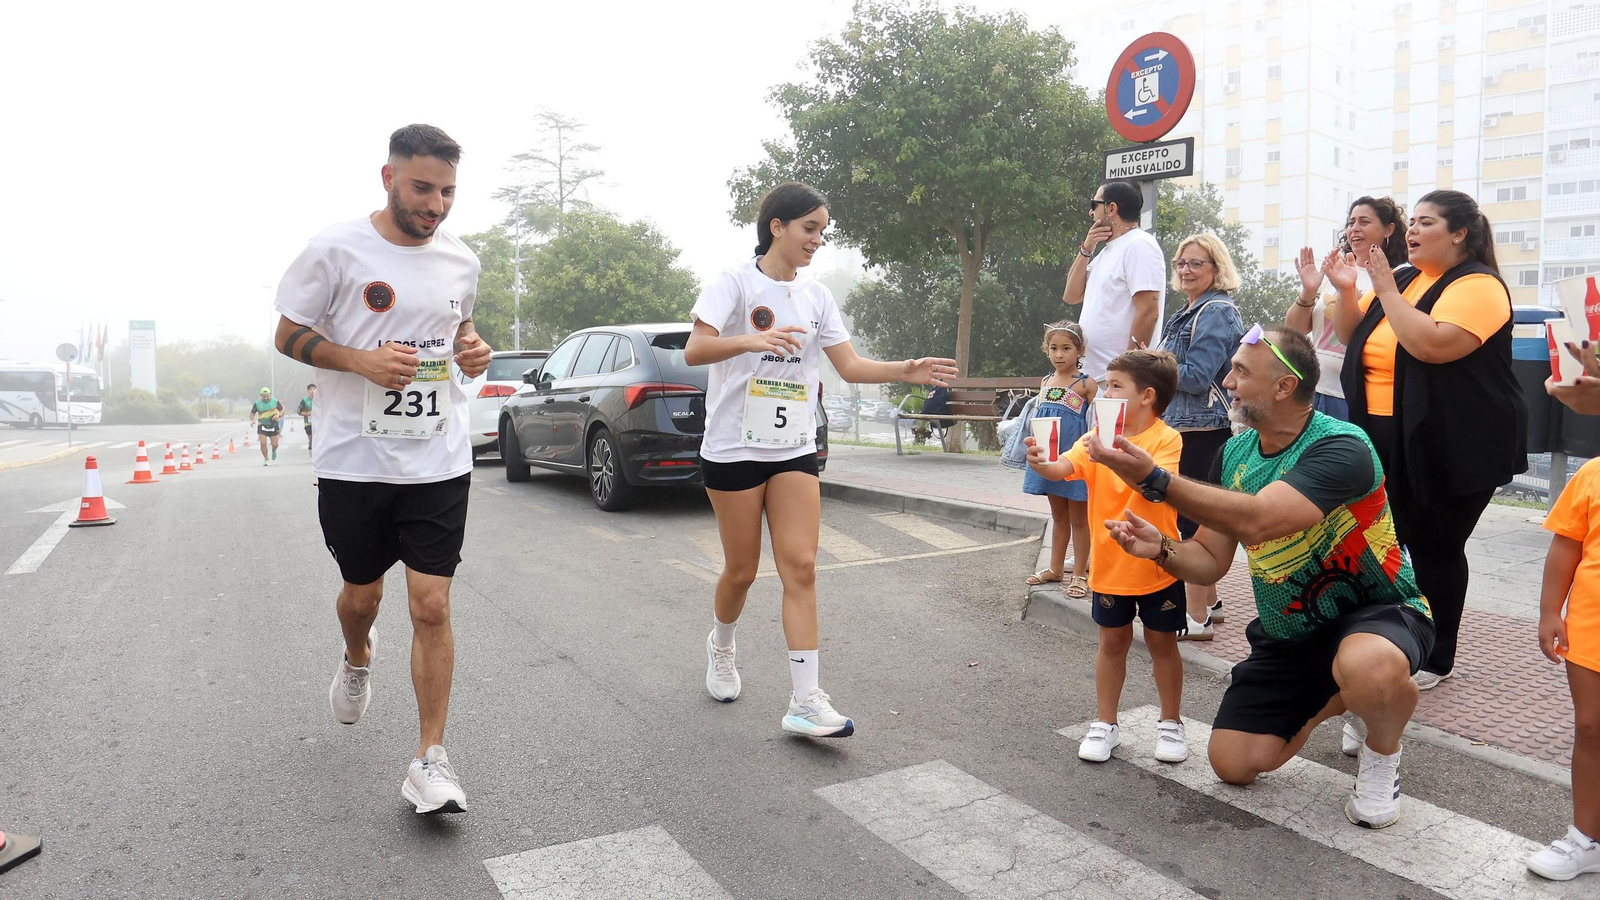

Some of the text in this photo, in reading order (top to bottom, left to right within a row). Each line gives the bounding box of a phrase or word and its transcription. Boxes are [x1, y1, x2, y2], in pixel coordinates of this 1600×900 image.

[1131, 64, 1162, 78] EXCEPTO
[1121, 149, 1168, 163] EXCEPTO
[1109, 160, 1180, 177] MINUSVALIDO
[418, 338, 446, 348] JEREZ
[756, 379, 782, 387] CARRERA
[783, 382, 805, 390] SOLIDARIA
[384, 390, 440, 417] 231
[774, 406, 788, 429] 5
